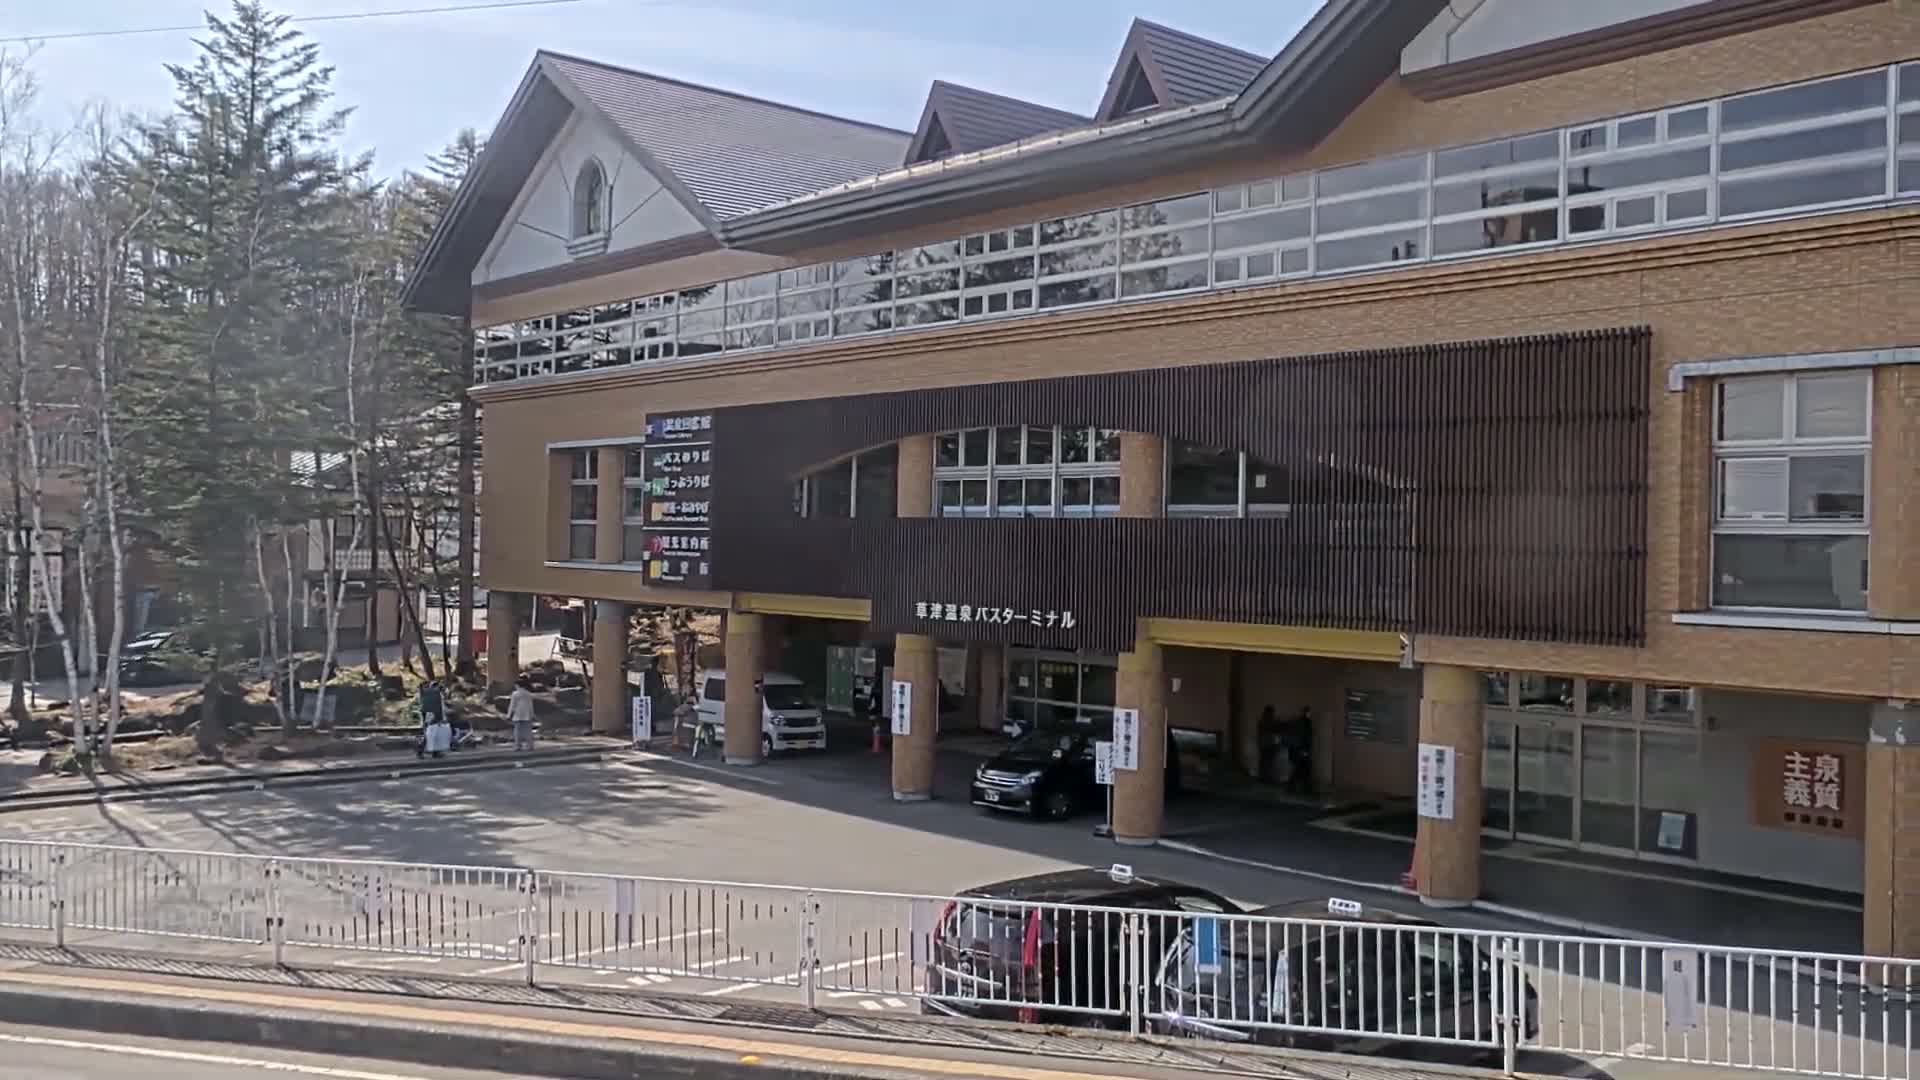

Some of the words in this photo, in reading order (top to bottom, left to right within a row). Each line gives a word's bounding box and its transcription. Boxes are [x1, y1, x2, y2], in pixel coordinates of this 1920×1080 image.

[915, 602, 1077, 629] 草津温泉バスターミナル
